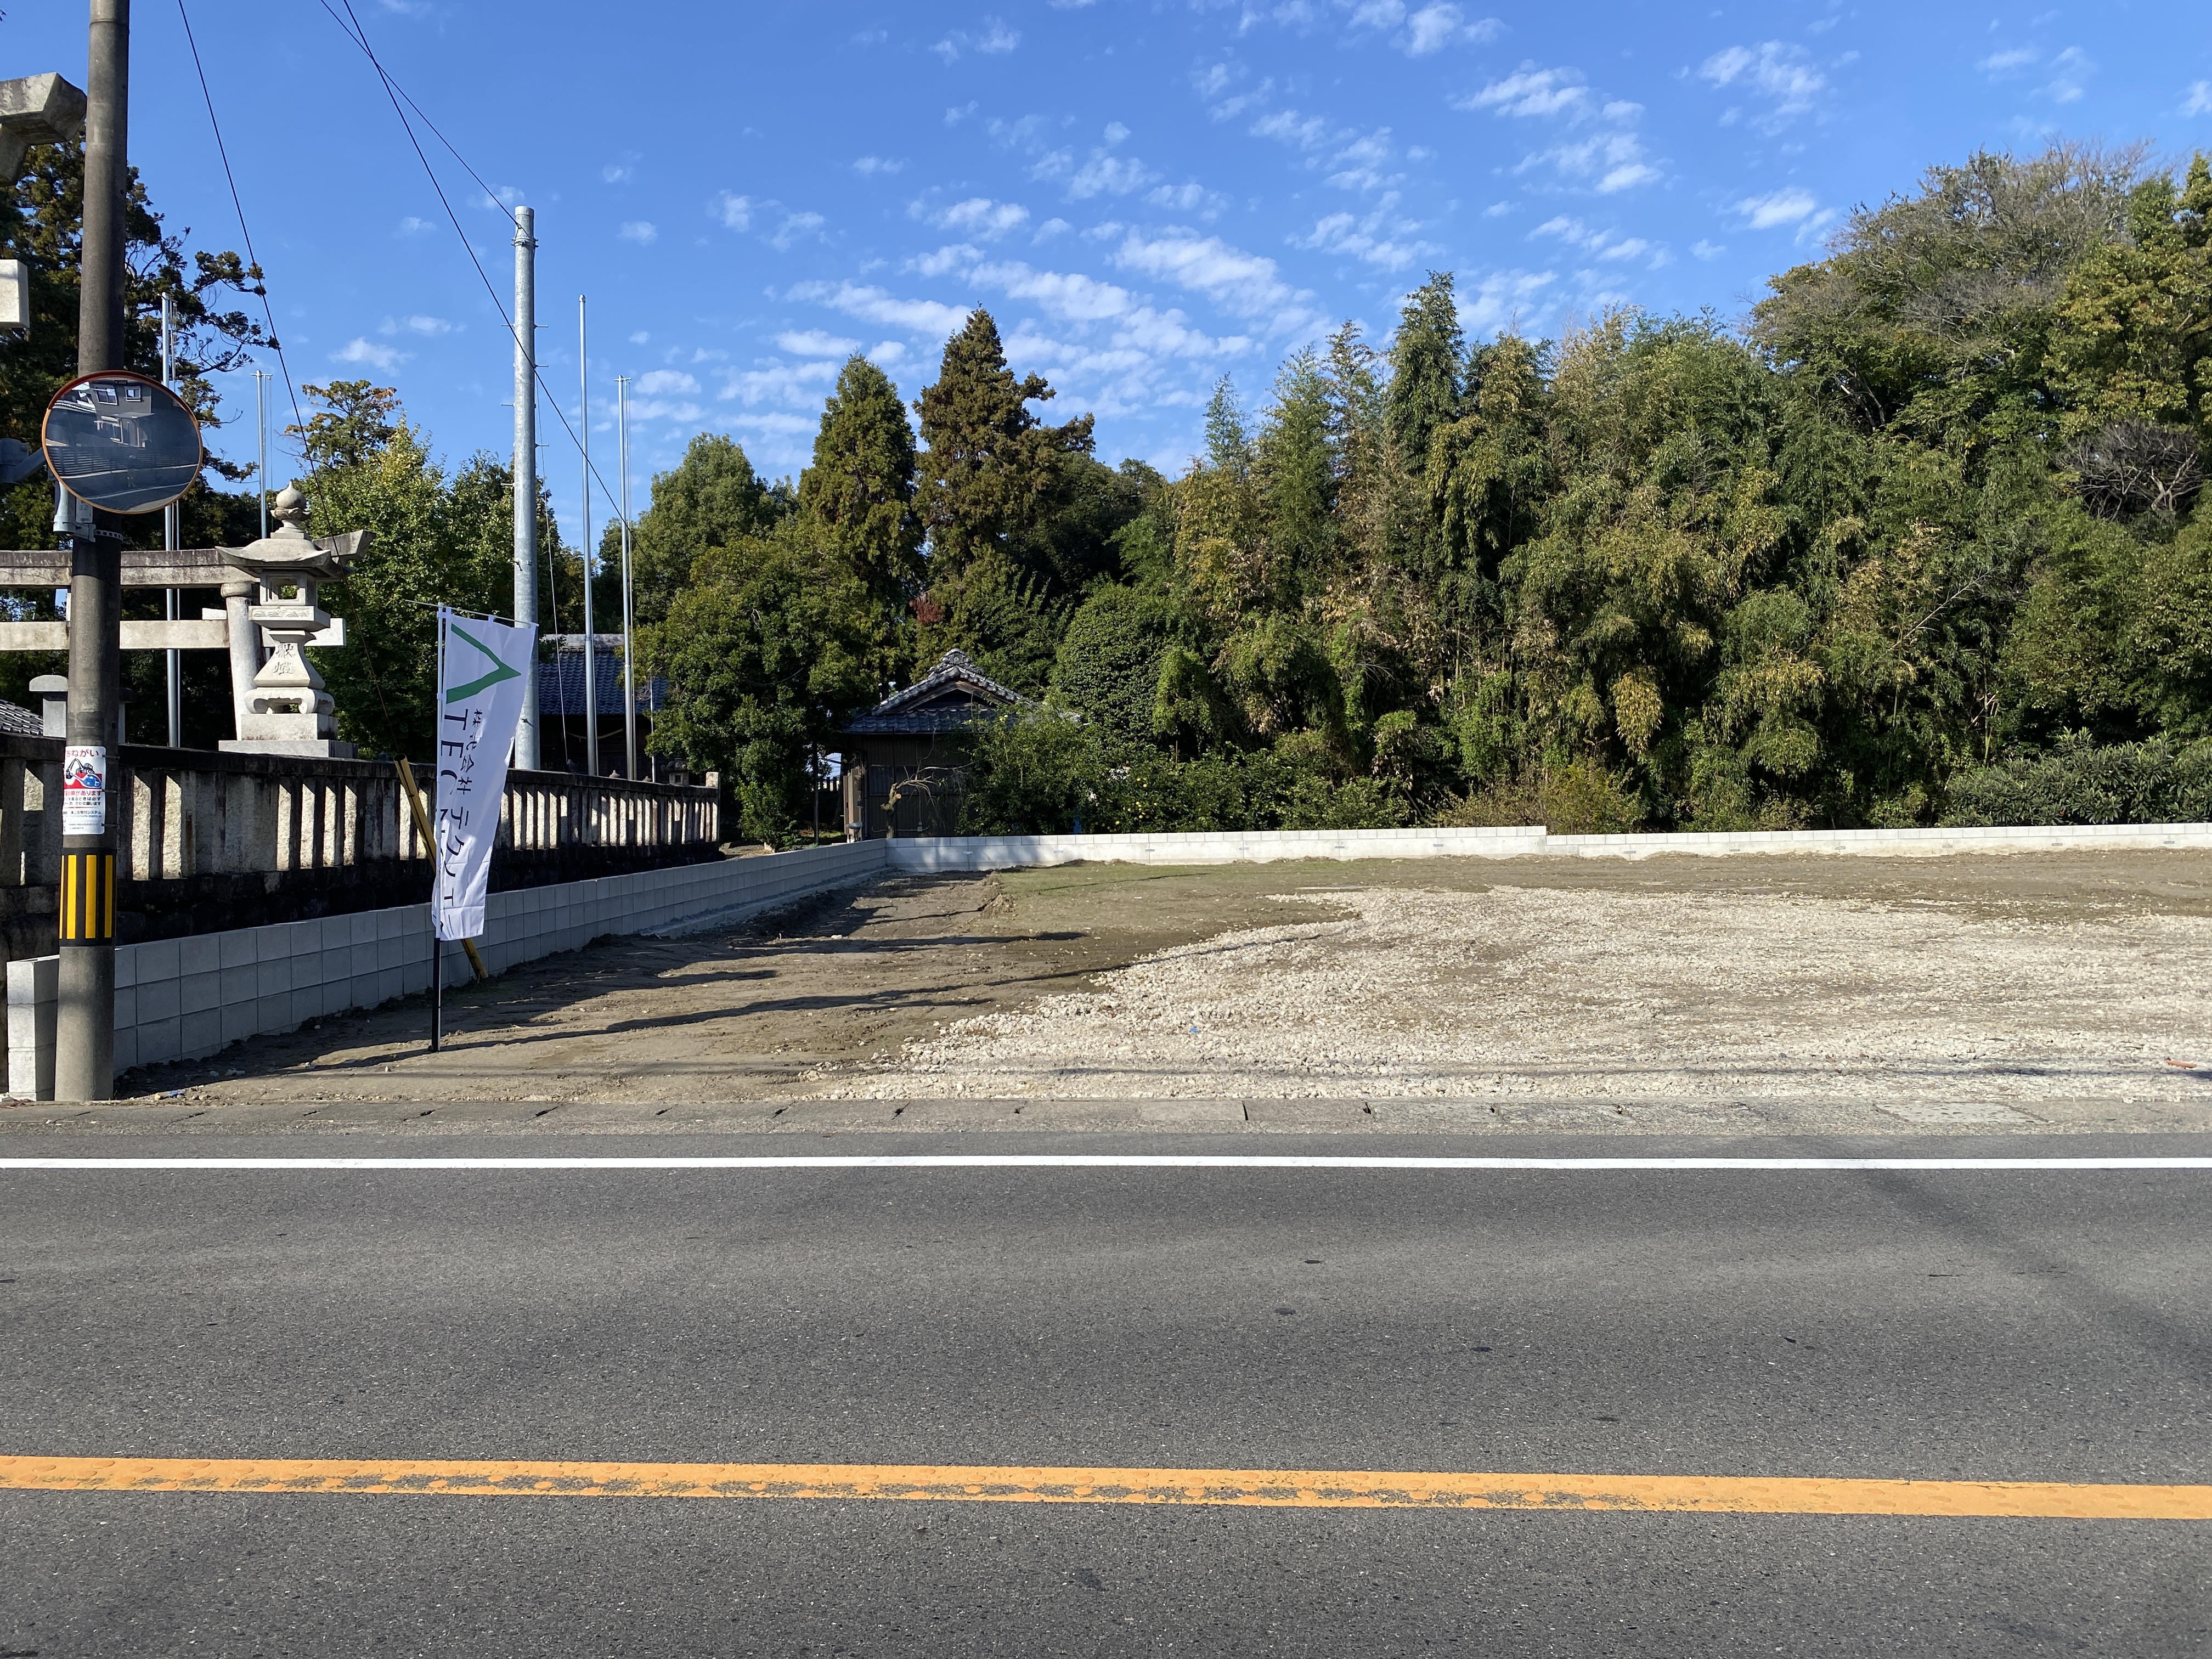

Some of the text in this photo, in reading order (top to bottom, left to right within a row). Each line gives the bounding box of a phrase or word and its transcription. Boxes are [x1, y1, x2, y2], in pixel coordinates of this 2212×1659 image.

[66, 749, 99, 758] おねがい
[456, 708, 483, 795] 株式会社
